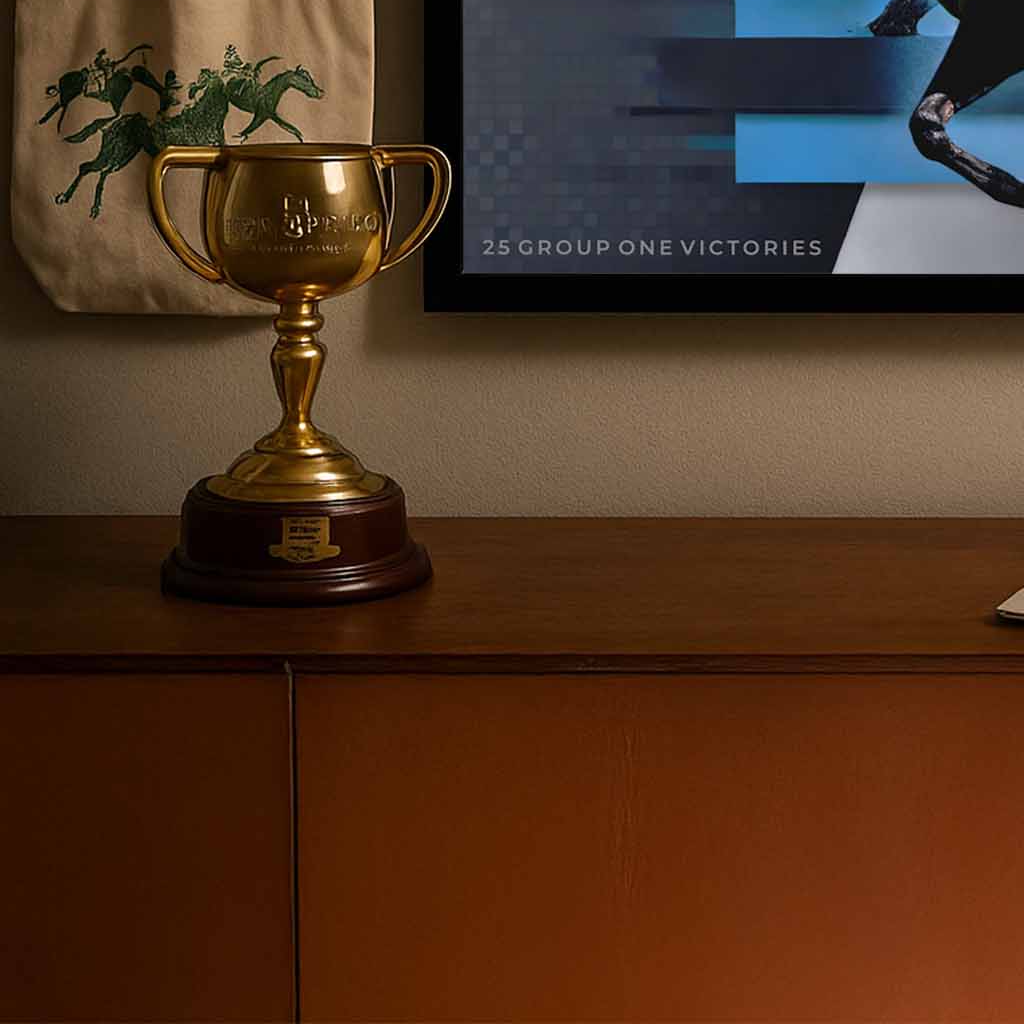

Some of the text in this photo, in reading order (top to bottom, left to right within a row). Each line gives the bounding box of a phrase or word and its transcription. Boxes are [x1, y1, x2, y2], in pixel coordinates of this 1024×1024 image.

[482, 240, 822, 256] 25 GROUP ONE VICTORIES
